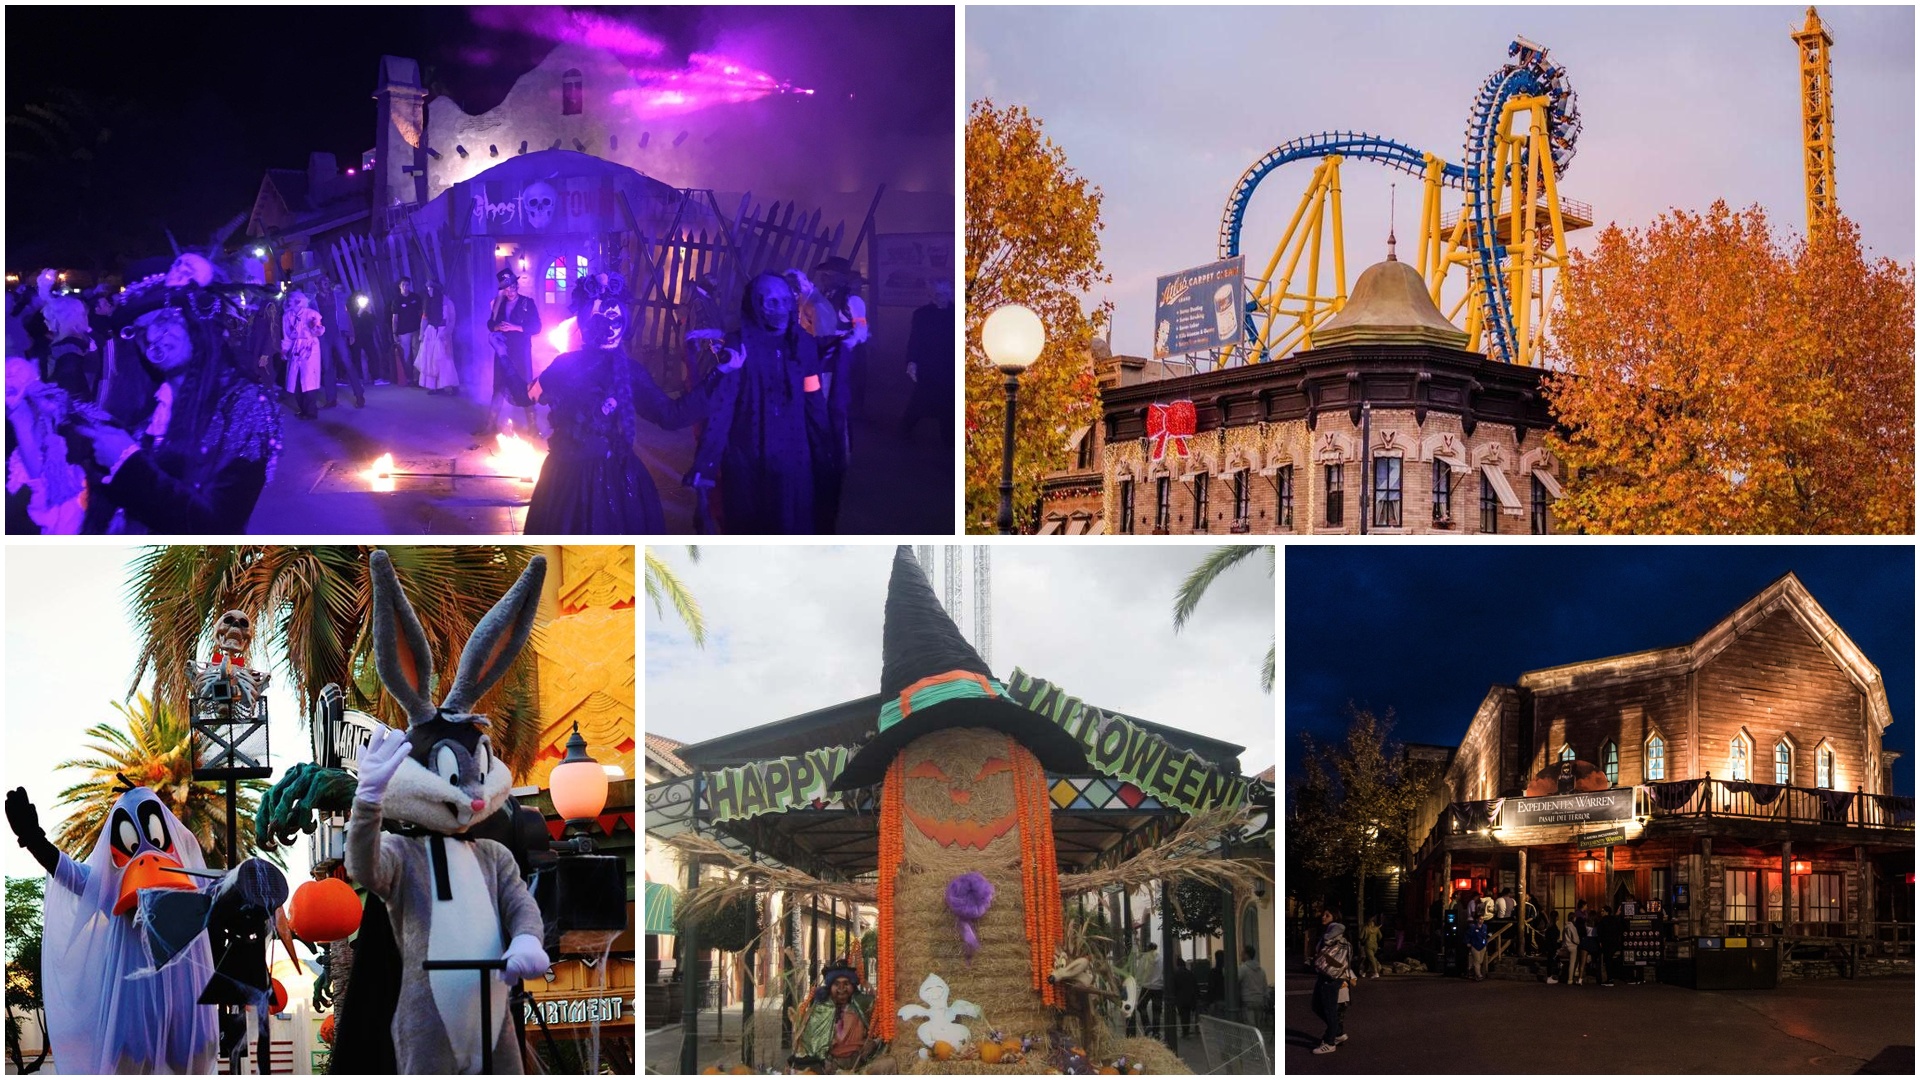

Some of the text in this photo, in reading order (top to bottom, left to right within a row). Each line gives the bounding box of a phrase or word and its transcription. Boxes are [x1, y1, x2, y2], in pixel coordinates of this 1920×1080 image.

[1188, 273, 1214, 286] CARPET
[708, 748, 846, 822] HAPPY
[1568, 812, 1591, 821] TERROR
